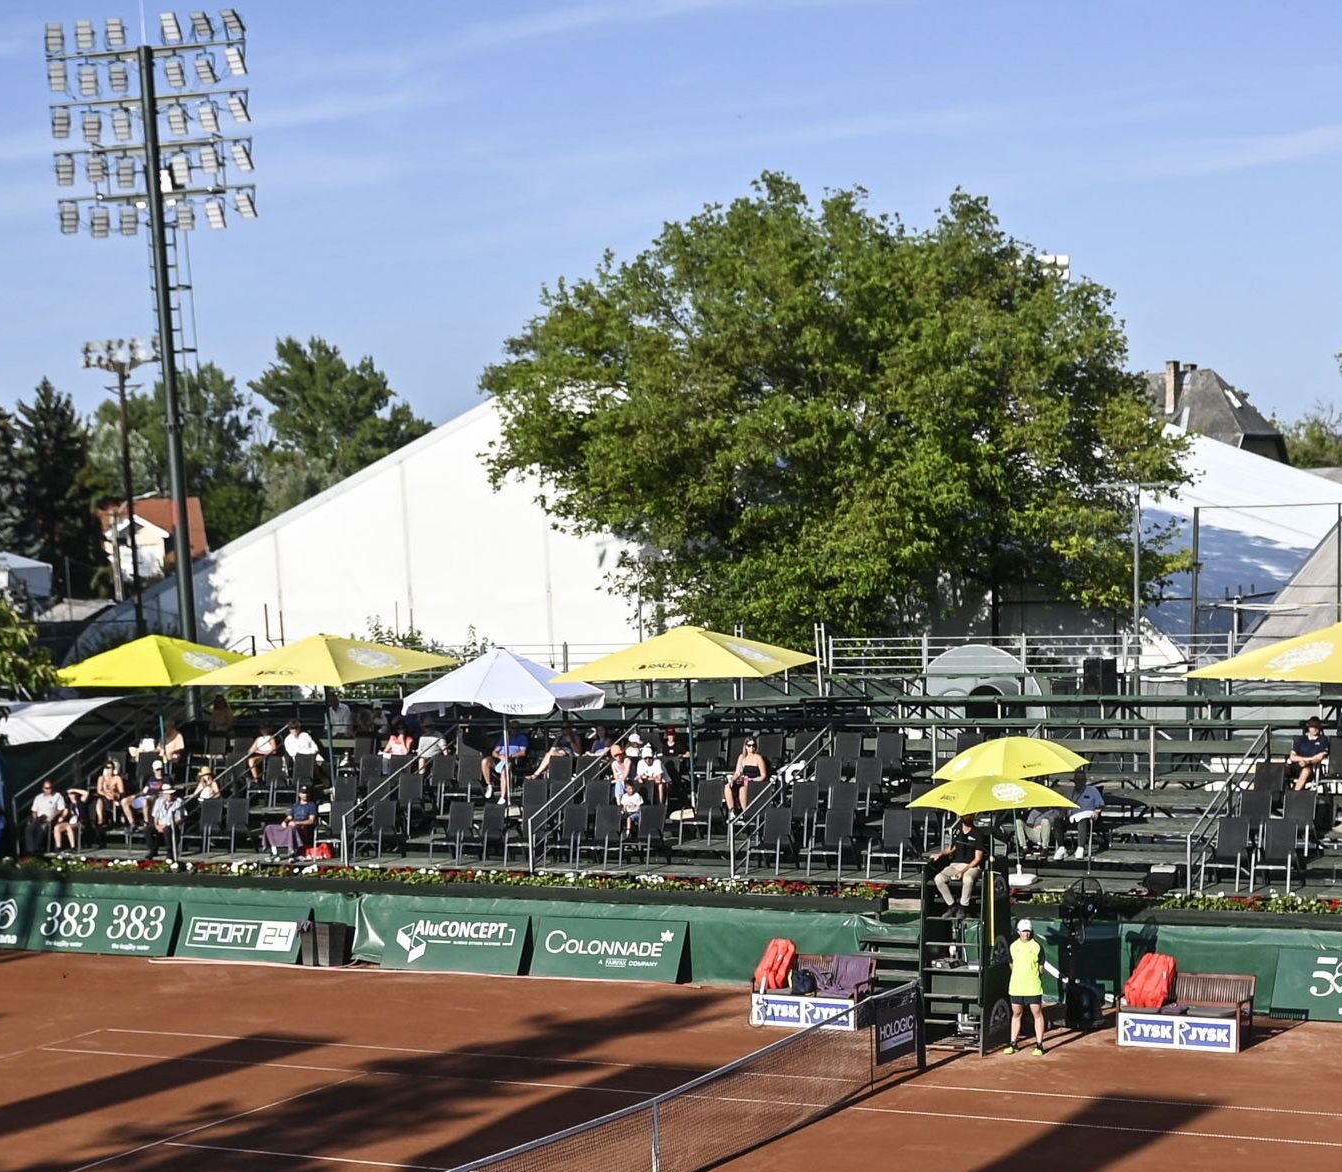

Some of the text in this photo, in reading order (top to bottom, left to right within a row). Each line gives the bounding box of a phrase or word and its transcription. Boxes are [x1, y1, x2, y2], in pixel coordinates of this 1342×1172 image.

[646, 660, 688, 671] RAUCH
[40, 902, 98, 938] 383
[107, 904, 166, 941] 383
[414, 920, 508, 938] AluCONCEPT
[192, 921, 293, 945] SPORT 24
[545, 930, 664, 957] COLONNADE
[765, 1003, 800, 1019] JYSK
[880, 1015, 914, 1041] HOLOGIC
[1133, 1023, 1173, 1039] JYSK
[1188, 1027, 1229, 1043] JYSK
